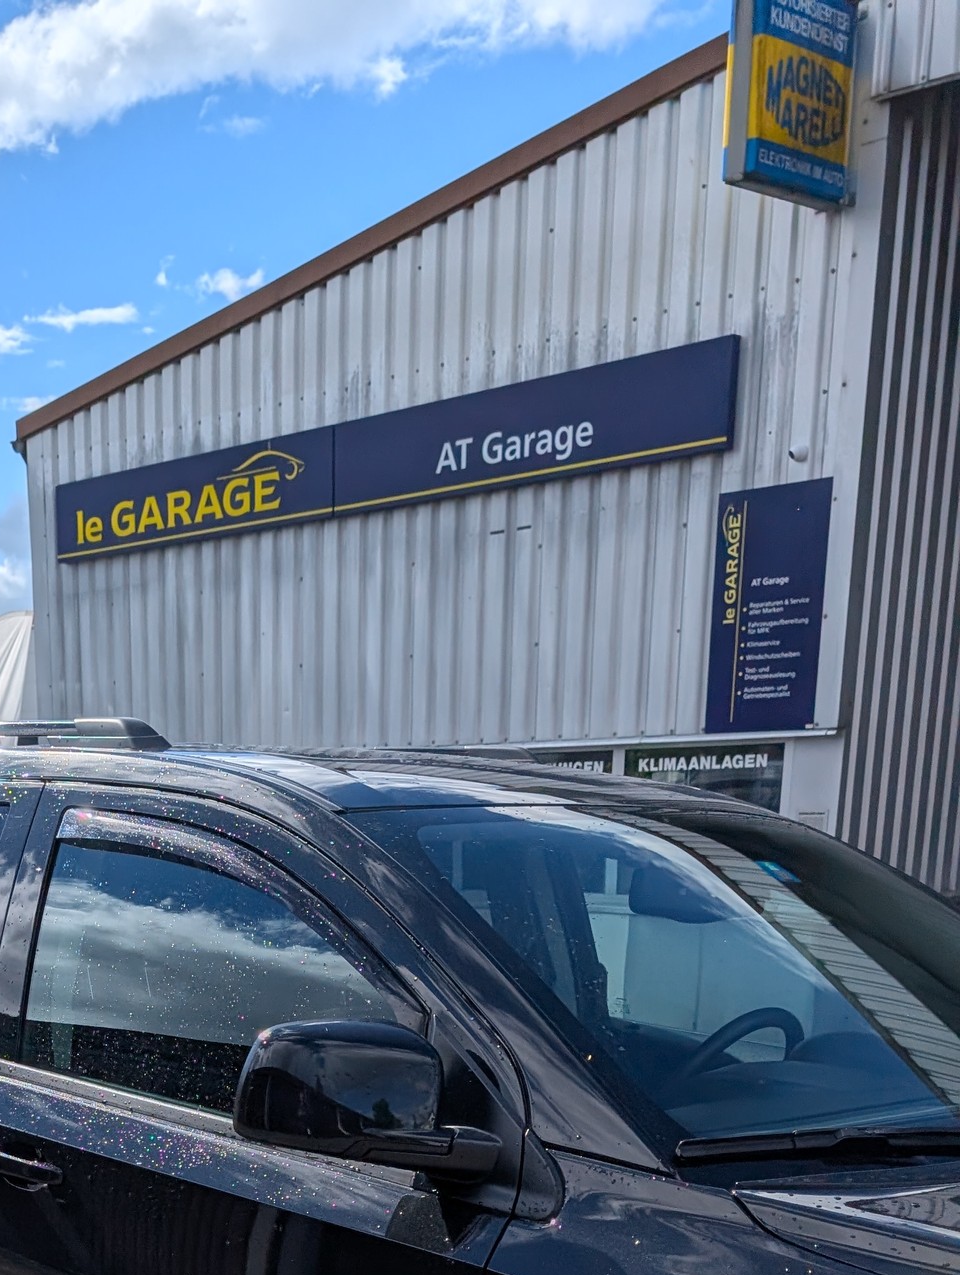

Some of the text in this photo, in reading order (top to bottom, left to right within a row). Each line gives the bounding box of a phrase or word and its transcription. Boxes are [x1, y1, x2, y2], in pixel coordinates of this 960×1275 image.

[770, 5, 849, 54] KUNDENDIENST
[758, 148, 812, 177] ELEKTRONIK
[435, 421, 594, 474] AT Garage
[76, 471, 281, 544] le GARAGE
[722, 513, 741, 624] le GARAGE
[751, 577, 790, 587] AT Garage
[638, 753, 769, 772] KLIMAANLAGEN
